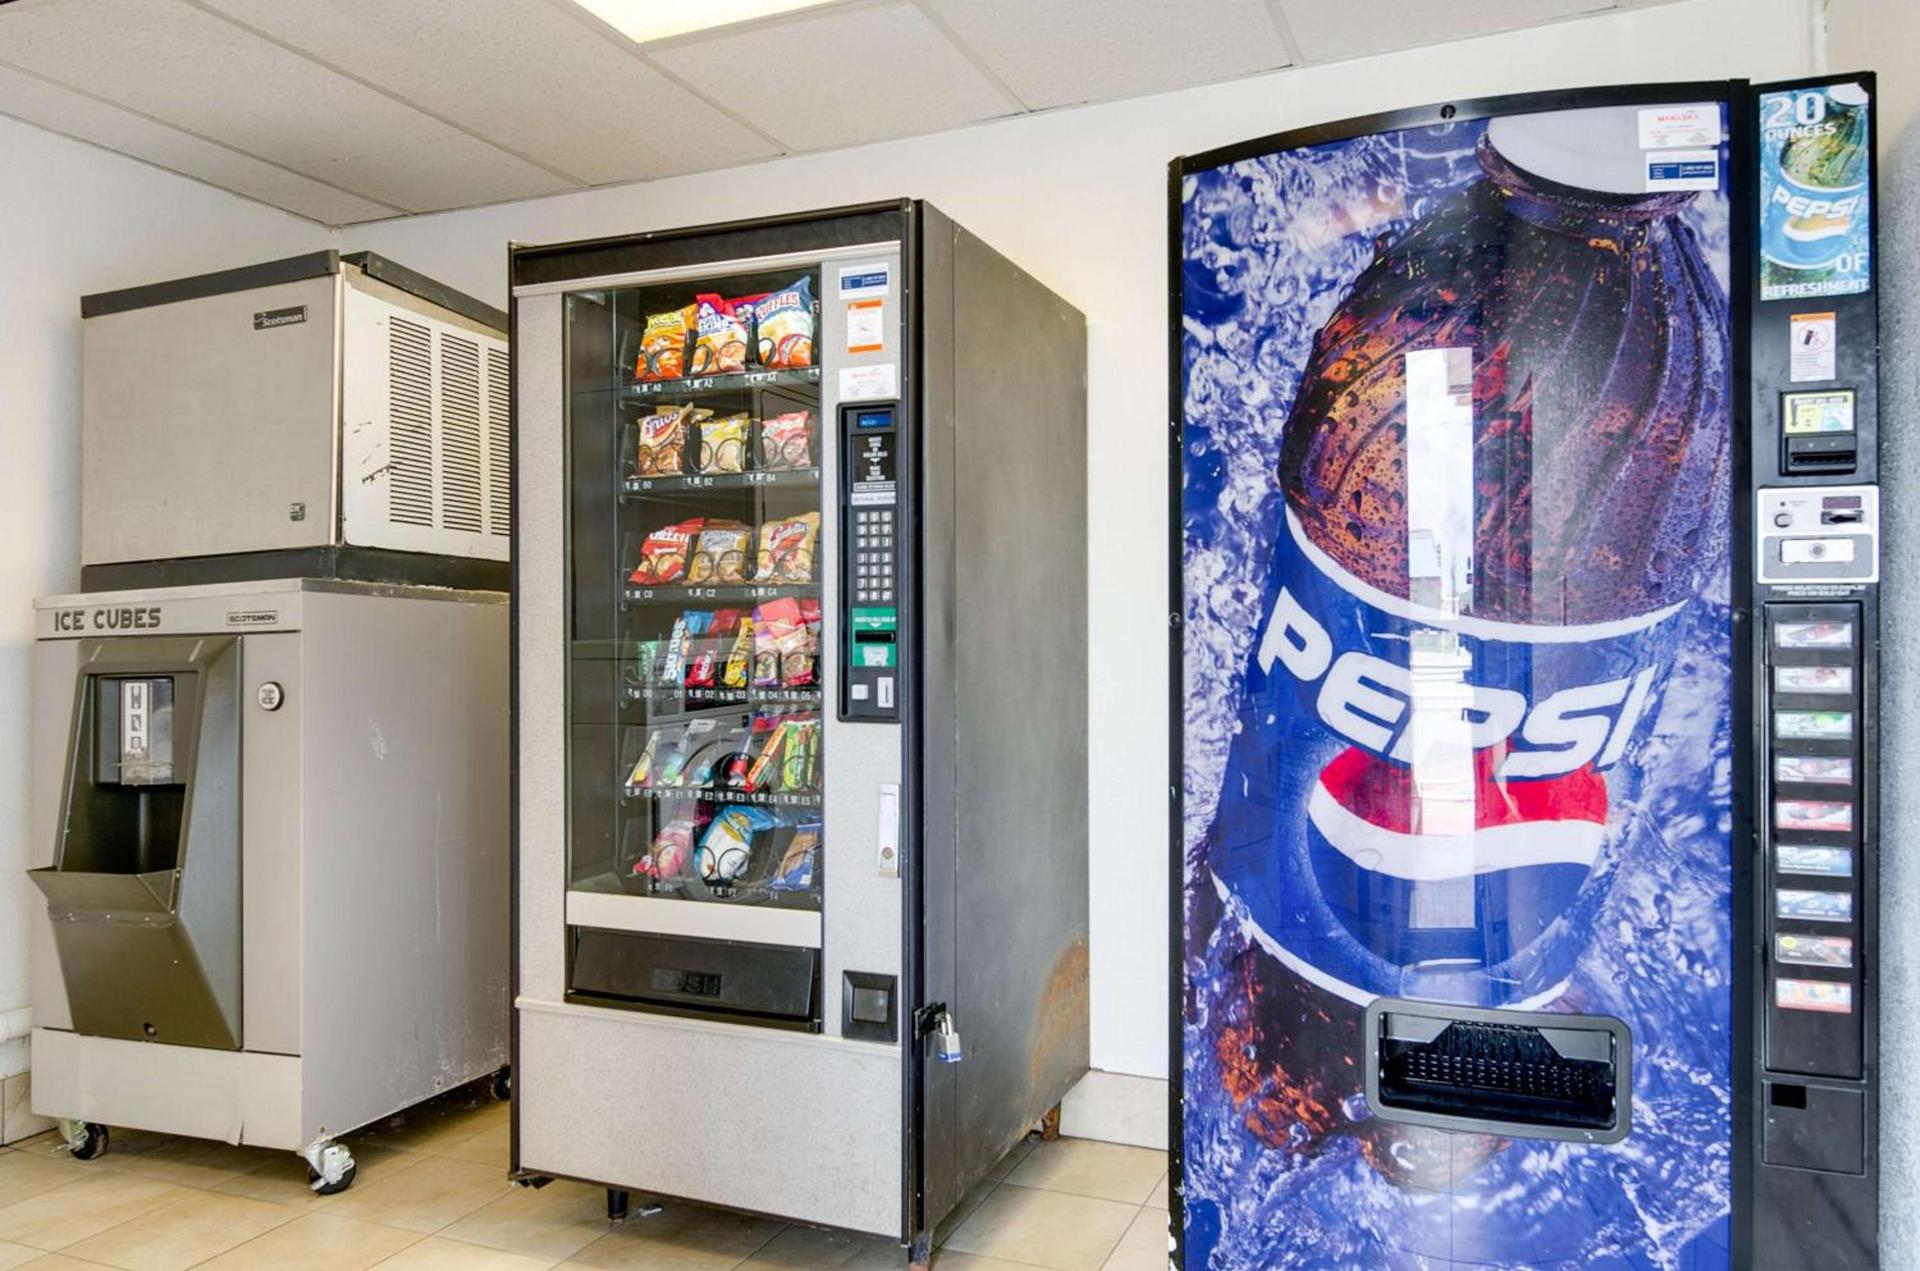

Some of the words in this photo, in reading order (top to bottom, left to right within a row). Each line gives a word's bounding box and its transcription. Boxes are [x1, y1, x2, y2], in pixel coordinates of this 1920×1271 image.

[1765, 92, 1826, 128] 20
[1764, 122, 1837, 141] OUNCES
[1771, 184, 1860, 219] PEPSI
[1836, 252, 1869, 273] OF
[1762, 278, 1869, 299] REFRESHMENT
[756, 291, 801, 319] RUFFLES
[261, 313, 303, 327] Scotsman
[54, 610, 85, 632] ICE
[93, 607, 162, 631] CUBES
[229, 614, 276, 623] SCOTSMAN
[1258, 586, 1658, 777] PEPSI
[704, 791, 714, 801] E2
